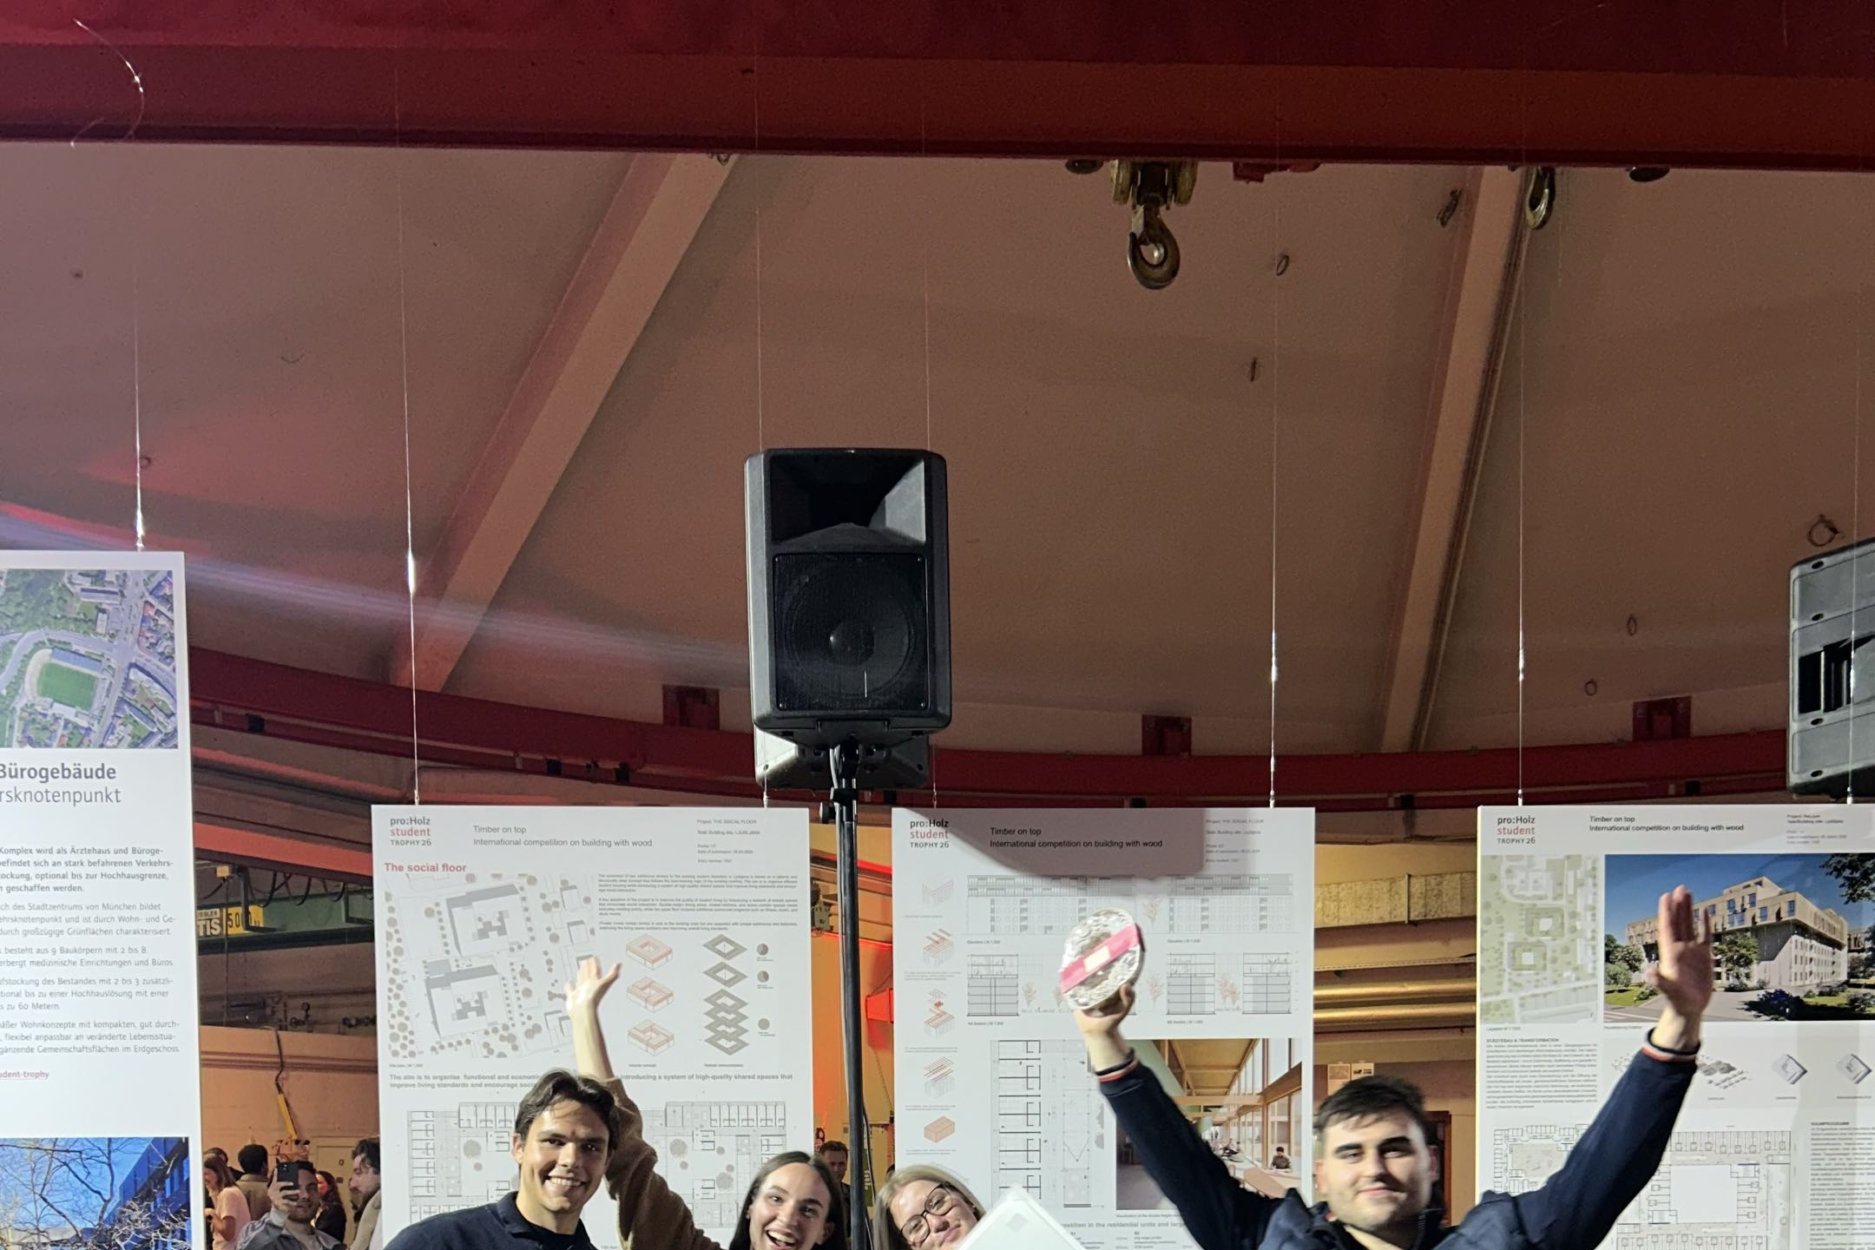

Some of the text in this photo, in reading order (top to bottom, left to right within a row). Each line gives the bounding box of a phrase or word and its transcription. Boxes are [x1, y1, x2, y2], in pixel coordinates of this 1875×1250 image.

[390, 816, 430, 827] pro:Holz
[910, 818, 949, 829] pro:Holz
[1497, 815, 1535, 827] pro:Holz
[1590, 815, 1613, 823] Timber
[390, 827, 430, 837] student
[473, 825, 500, 833] Timber
[514, 826, 526, 835] top
[990, 827, 1016, 836] Timber
[1029, 828, 1042, 837] top
[1497, 825, 1536, 835] student
[1682, 824, 1709, 832] building
[910, 829, 949, 838] student
[421, 838, 432, 846] 26
[473, 838, 522, 847] International
[523, 838, 568, 848] competition
[581, 838, 612, 848] building
[614, 839, 630, 847] with
[632, 839, 652, 847] wood
[940, 840, 951, 848] 26
[990, 839, 1036, 848] International
[1038, 840, 1081, 849] competition
[1094, 840, 1124, 849] building
[1526, 836, 1536, 845] 26
[35, 846, 53, 855] wird
[56, 846, 68, 855] als
[70, 845, 111, 855] Ärztehaus
[113, 846, 128, 855] und
[132, 846, 163, 856] Büroge-
[33, 858, 50, 867] sich
[64, 859, 85, 867] stark
[87, 858, 133, 867] befahrenen
[135, 858, 173, 867] Verkehrs-
[384, 862, 466, 872] The social floor
[34, 871, 68, 882] optional
[71, 871, 83, 880] bis
[100, 871, 168, 882] Hochhausgrenze,
[6, 883, 84, 894] geschaffen werden.
